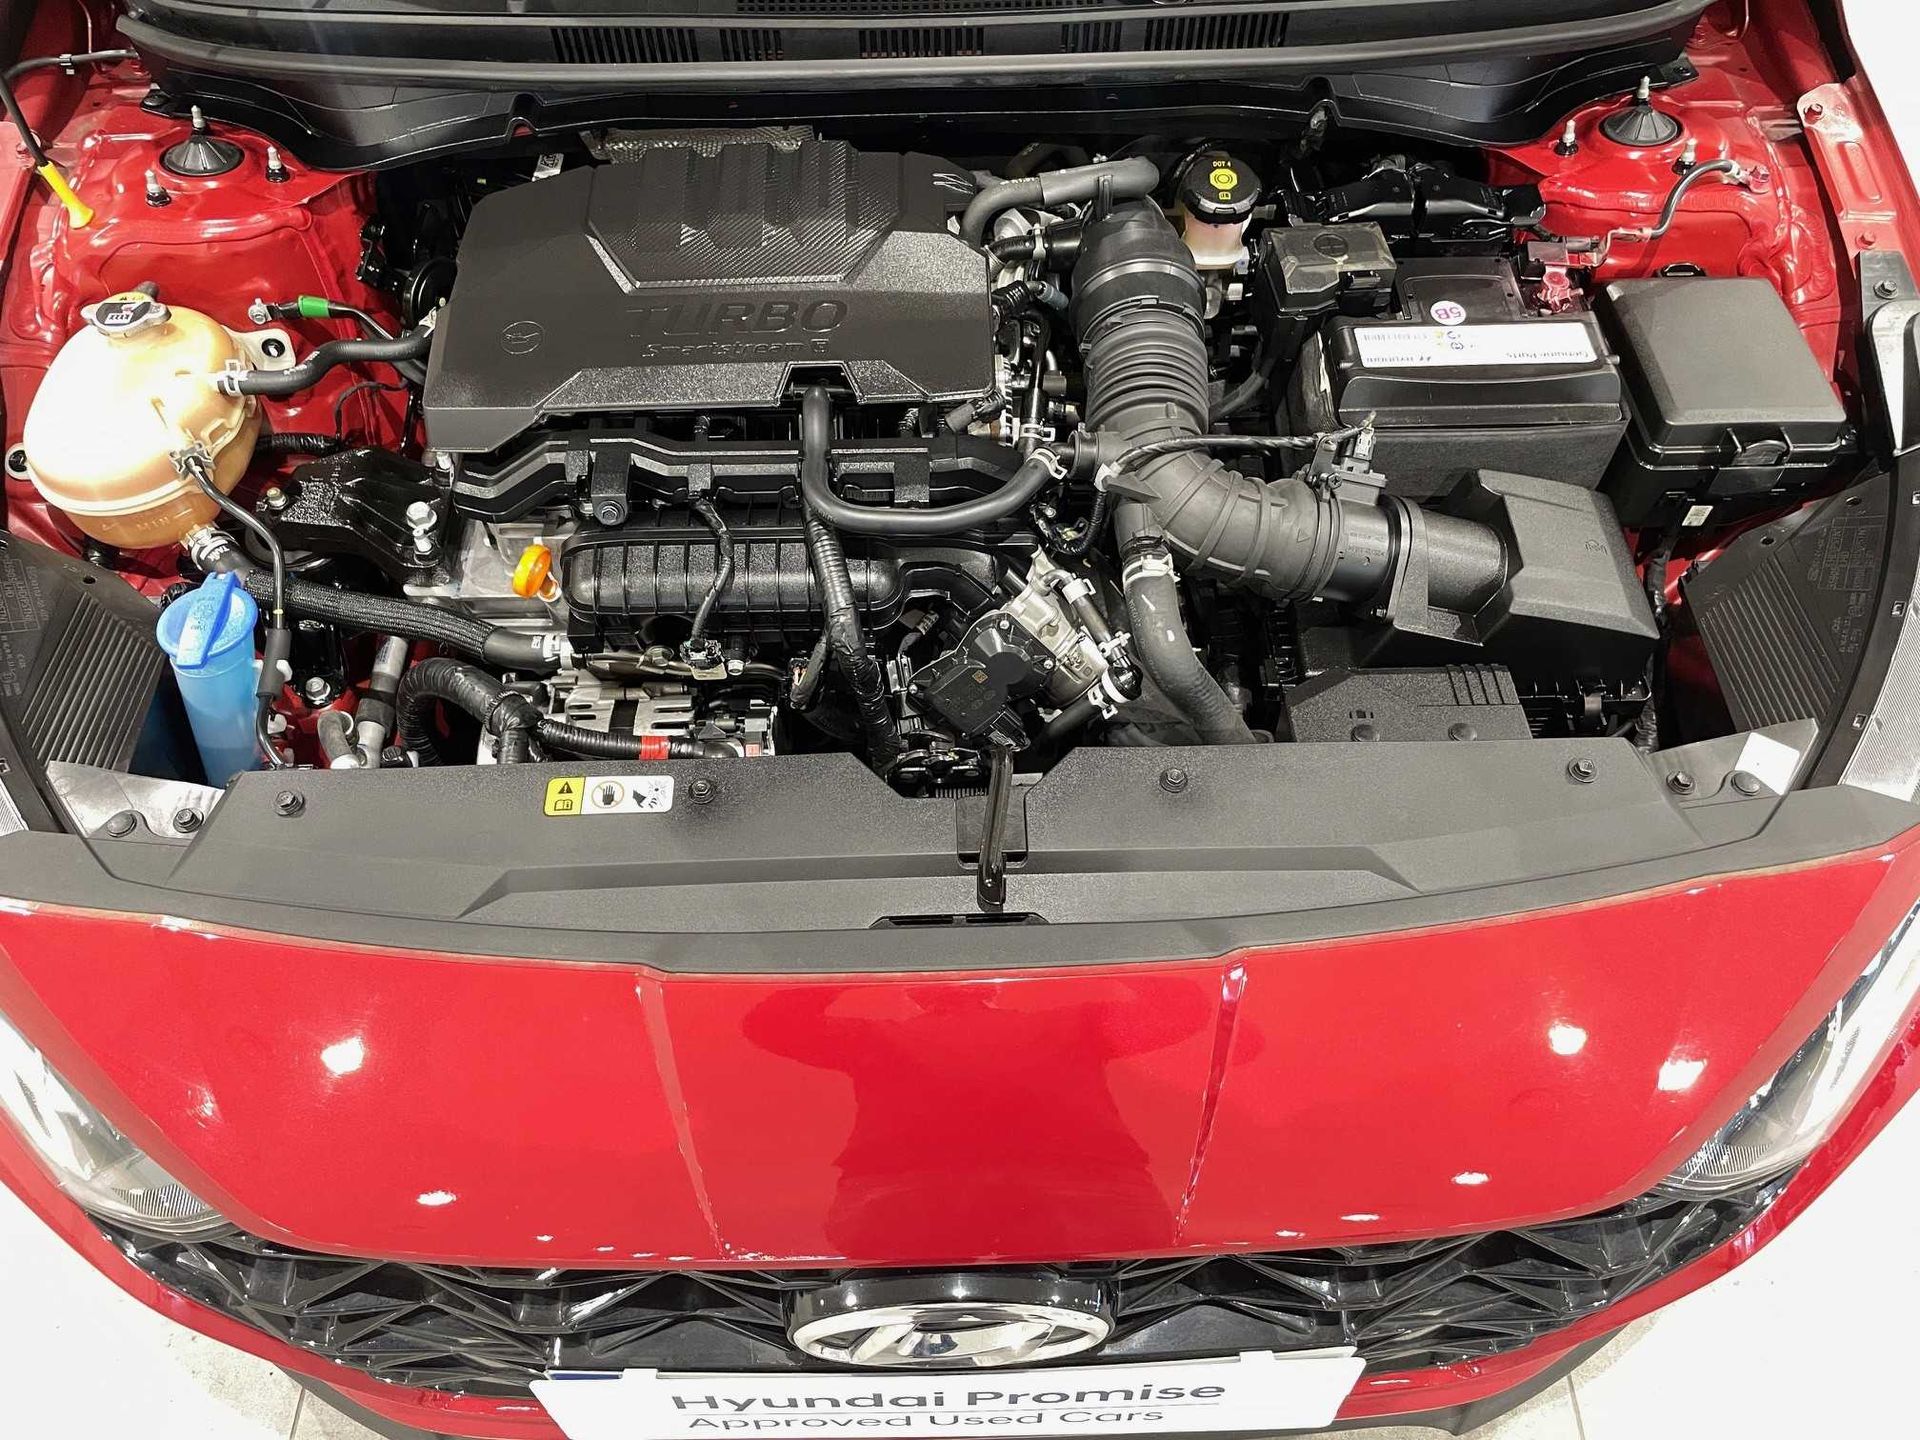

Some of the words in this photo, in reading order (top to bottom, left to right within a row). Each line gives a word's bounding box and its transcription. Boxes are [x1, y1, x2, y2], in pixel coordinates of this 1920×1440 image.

[624, 300, 848, 338] TURBO
[1435, 306, 1462, 320] 5B
[642, 341, 808, 359] Smartstream
[136, 515, 171, 531] MIN
[672, 1391, 944, 1411] Hyundai
[967, 1384, 1226, 1405] Promise
[689, 1415, 912, 1430] Approved
[929, 1412, 1043, 1426] Used
[1059, 1411, 1164, 1423] Cars
